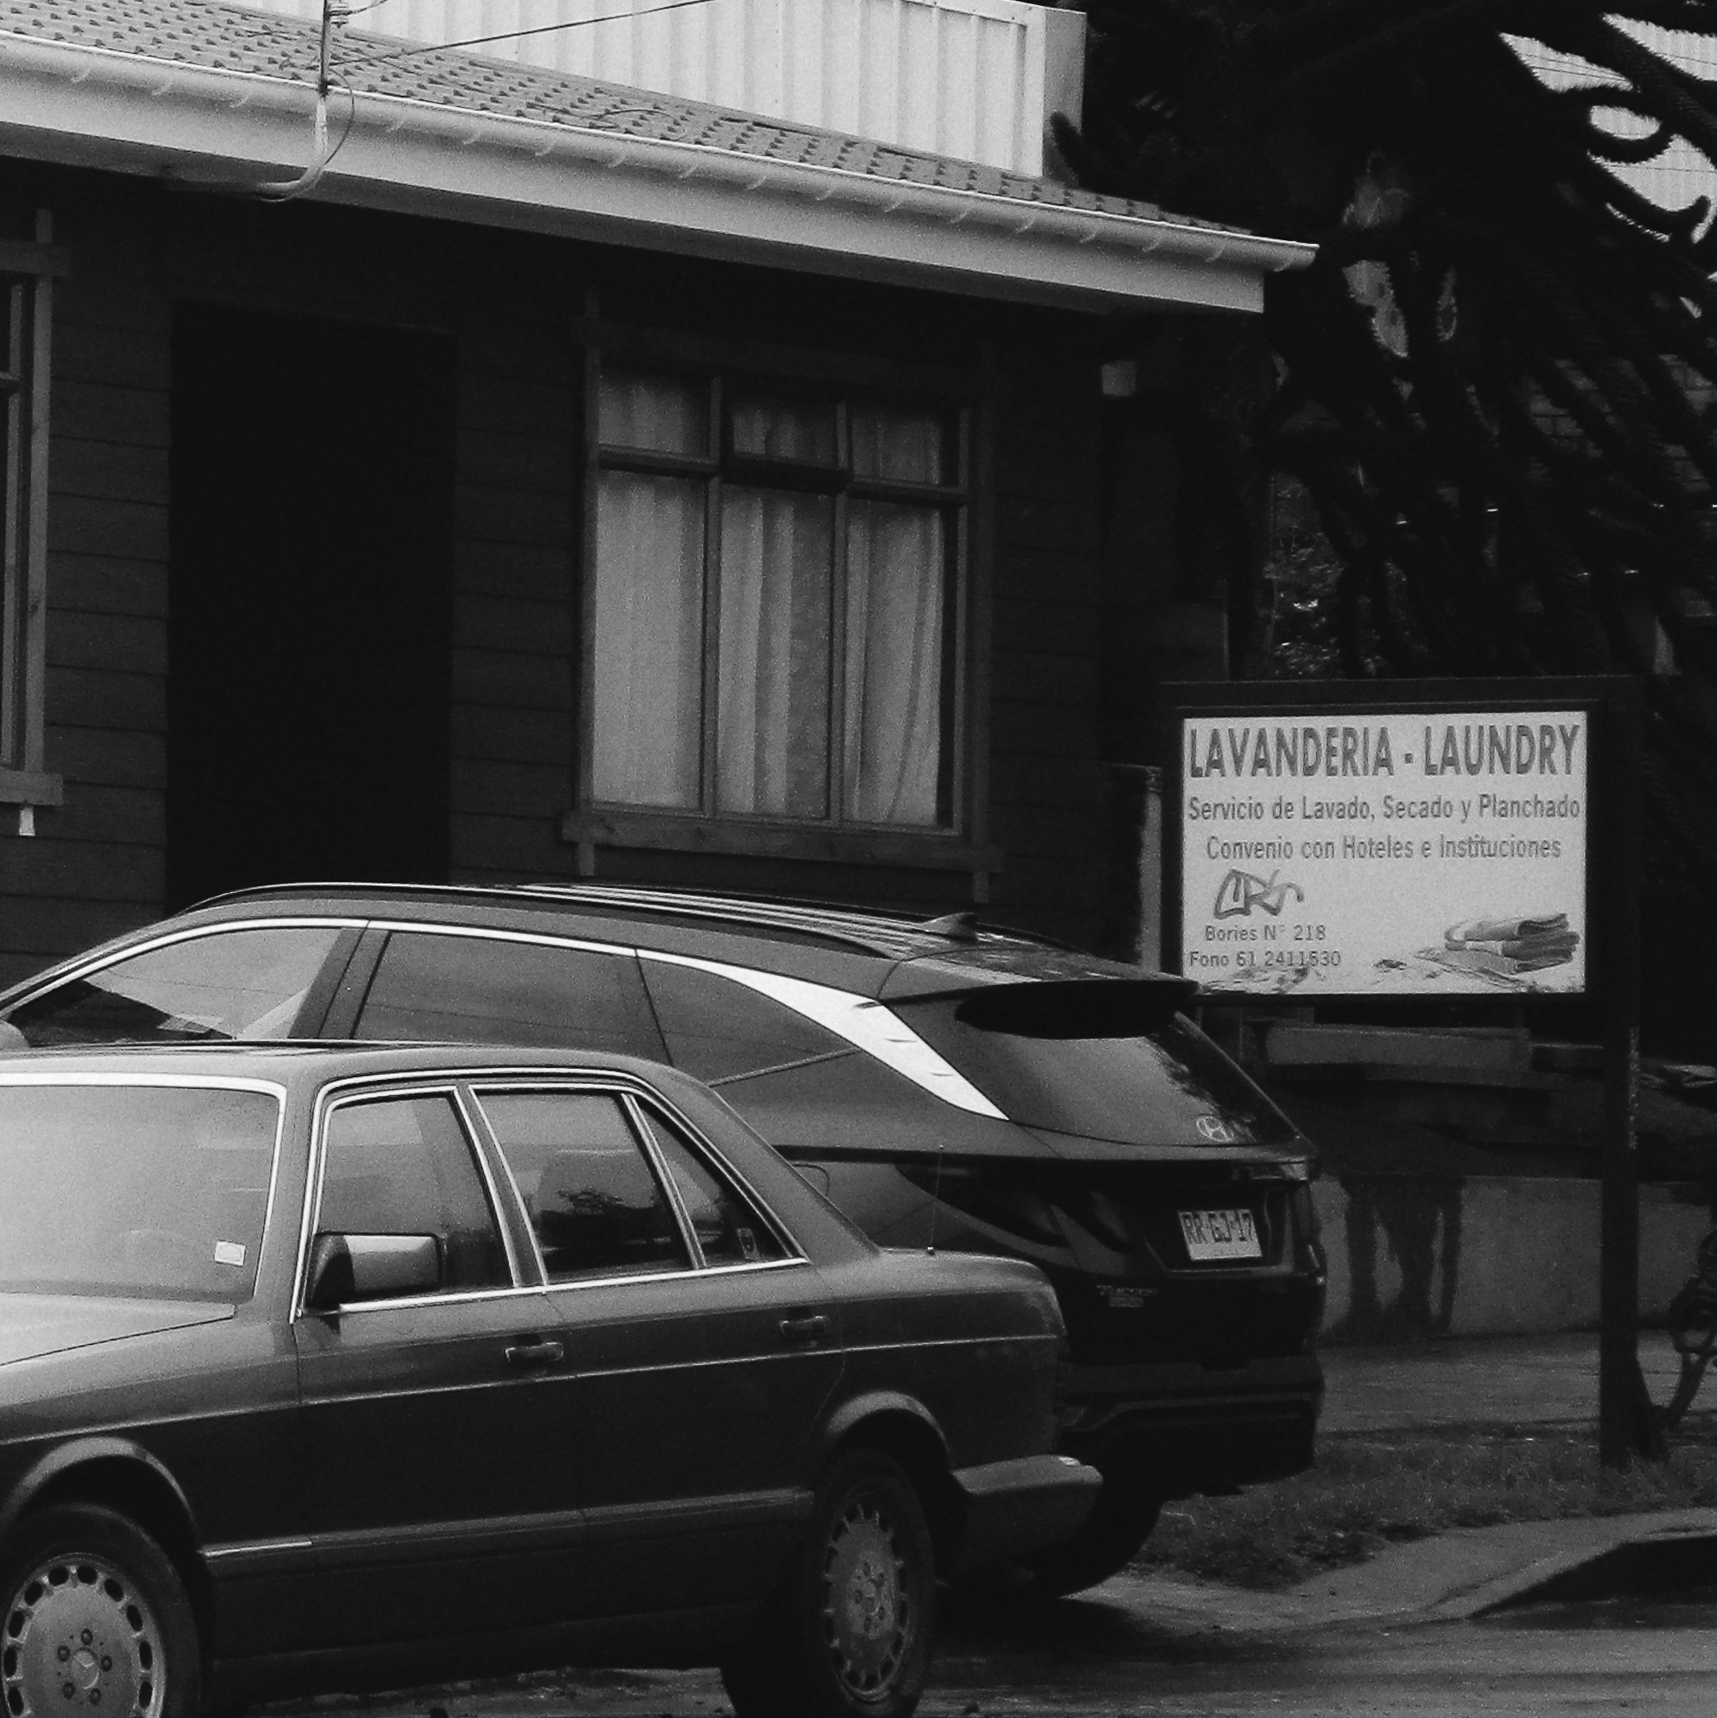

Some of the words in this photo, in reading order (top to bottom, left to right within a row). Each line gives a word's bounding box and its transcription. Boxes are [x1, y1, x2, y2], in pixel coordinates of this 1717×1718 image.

[1189, 726, 1395, 778] LAVANDERIA
[1424, 724, 1580, 776] LAUNDRY
[1188, 796, 1264, 821] Servicio
[1272, 796, 1294, 820] de
[1302, 795, 1376, 823] Lavado,
[1383, 794, 1454, 819] Secado
[1461, 800, 1472, 824] y
[1479, 793, 1580, 819] Planchado
[1206, 835, 1294, 860] Convenio
[1301, 841, 1335, 859] con
[1343, 835, 1414, 859] Hoteles
[1421, 840, 1432, 858] e
[1440, 833, 1562, 859] Instituciones
[1205, 924, 1258, 942] Bories
[1294, 924, 1326, 941] 218
[1189, 951, 1229, 967] Fono
[1236, 950, 1256, 966] 61
